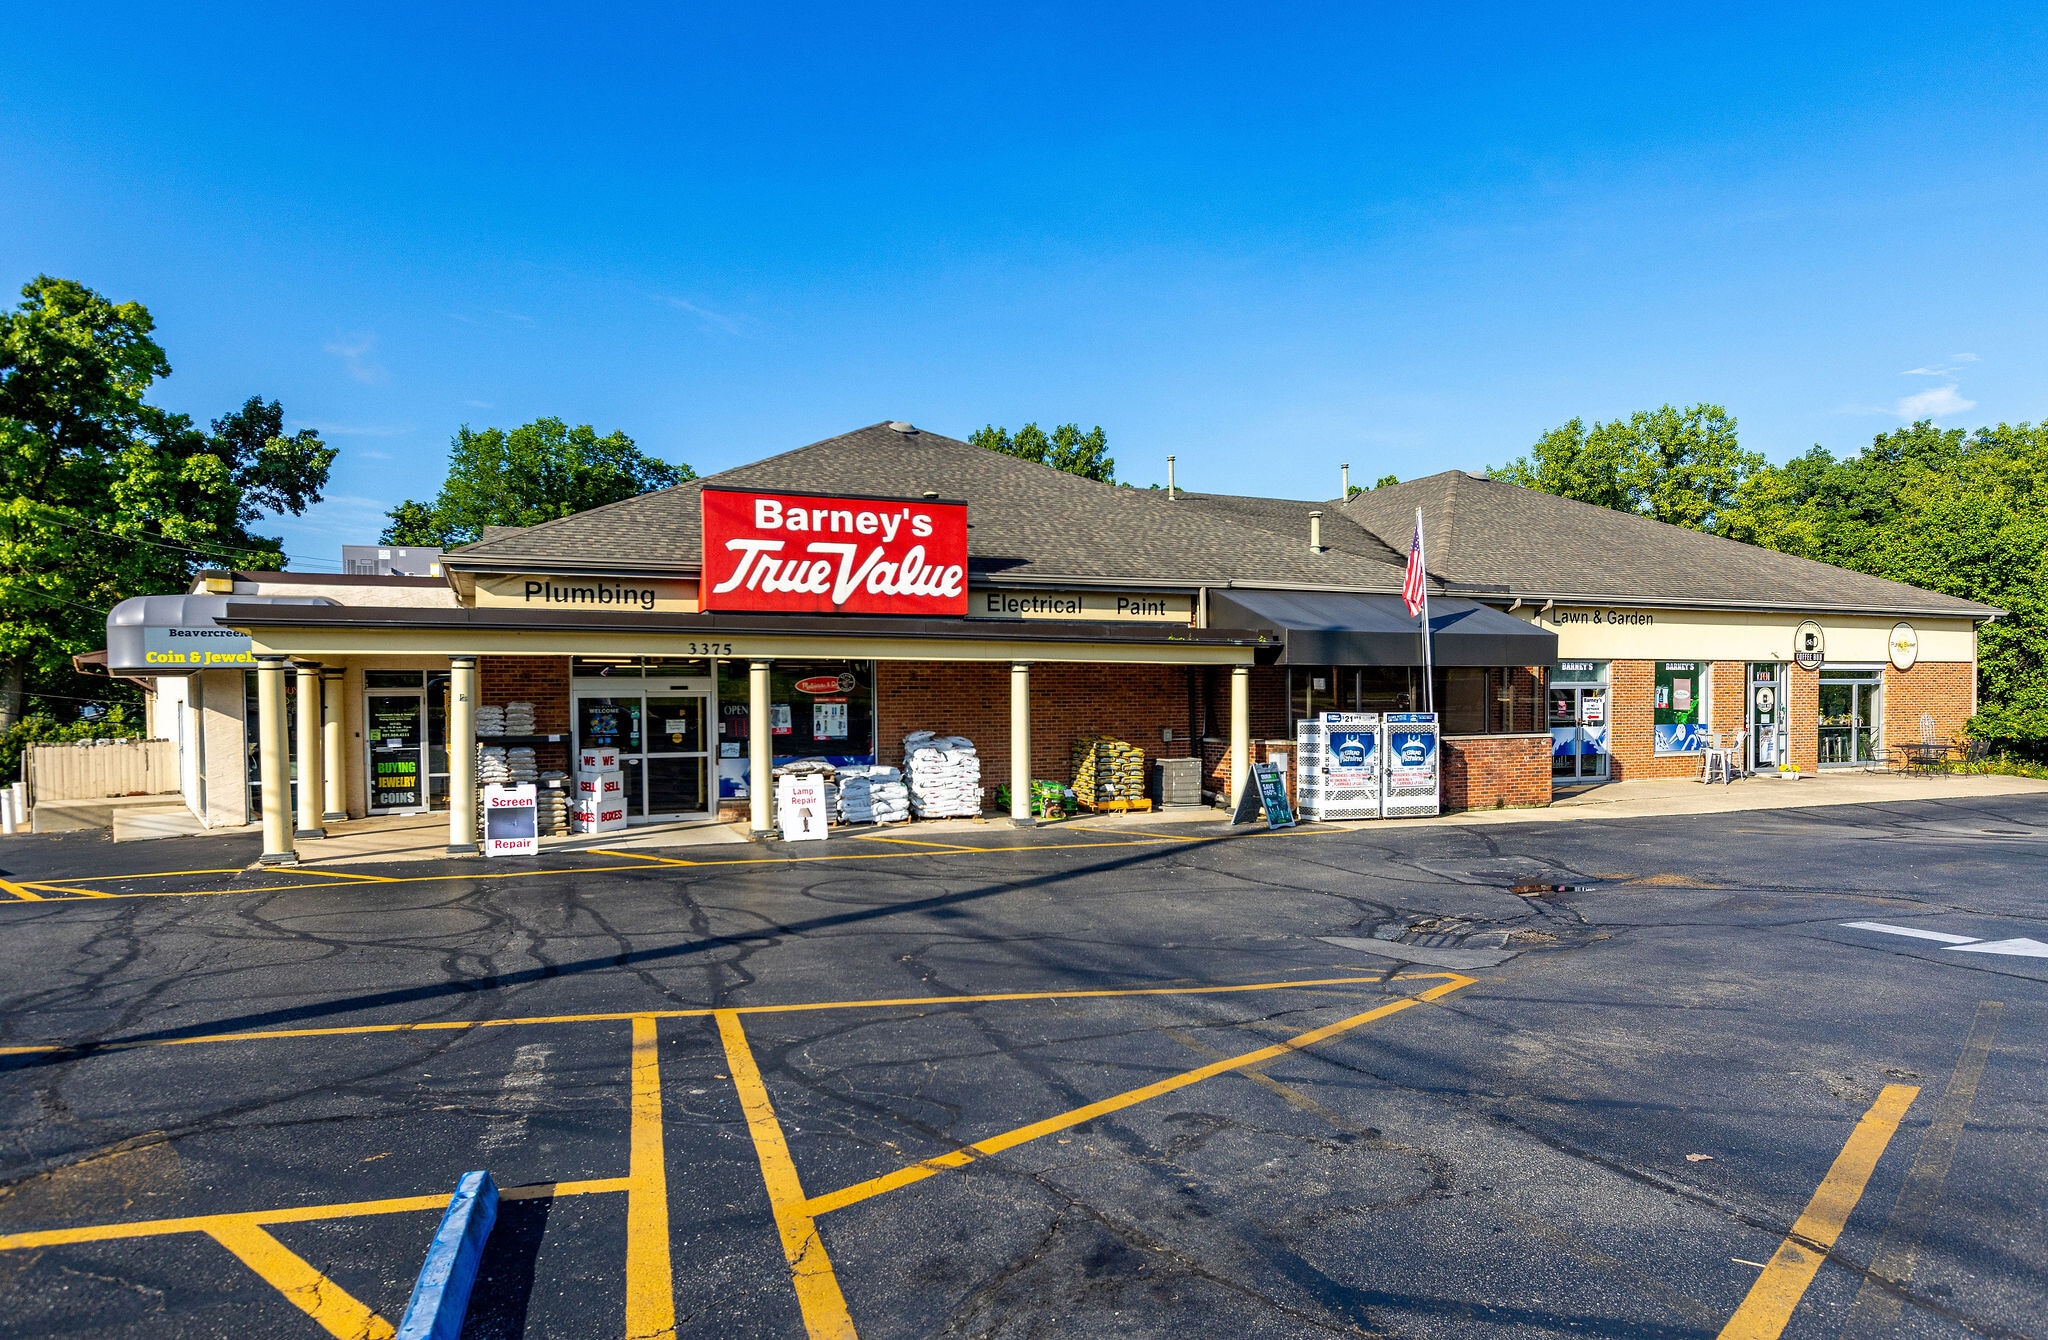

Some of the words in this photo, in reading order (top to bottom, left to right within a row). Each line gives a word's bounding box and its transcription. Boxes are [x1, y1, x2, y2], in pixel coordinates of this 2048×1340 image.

[754, 498, 933, 543] Barney's
[711, 538, 832, 594] True
[806, 541, 963, 605] Value
[525, 580, 656, 610] Plumbing
[986, 593, 1083, 614] Electrical
[1117, 597, 1166, 616] Paint
[1553, 607, 1588, 624] Lawn
[1593, 609, 1602, 624] &
[1607, 610, 1654, 626] Garden
[687, 642, 732, 656] 3375
[145, 650, 187, 663] Coin
[189, 650, 202, 663] &
[203, 650, 258, 665] Jewel
[1796, 653, 1813, 661] COFFEE
[1665, 662, 1695, 671] BARNEY'S
[723, 704, 749, 716] OPEN
[583, 756, 596, 766] WE
[602, 755, 615, 766] WE
[377, 761, 417, 773] BUYING
[378, 775, 417, 788] JEWELRY
[580, 781, 597, 792] SELL
[604, 780, 621, 792] SELL
[380, 791, 416, 804] COINS
[792, 787, 814, 796] Lamp
[491, 797, 533, 807] Screen
[791, 796, 817, 805] Repair
[574, 810, 596, 823] BOXES
[601, 809, 623, 823] BOXES
[495, 838, 532, 849] Repair
